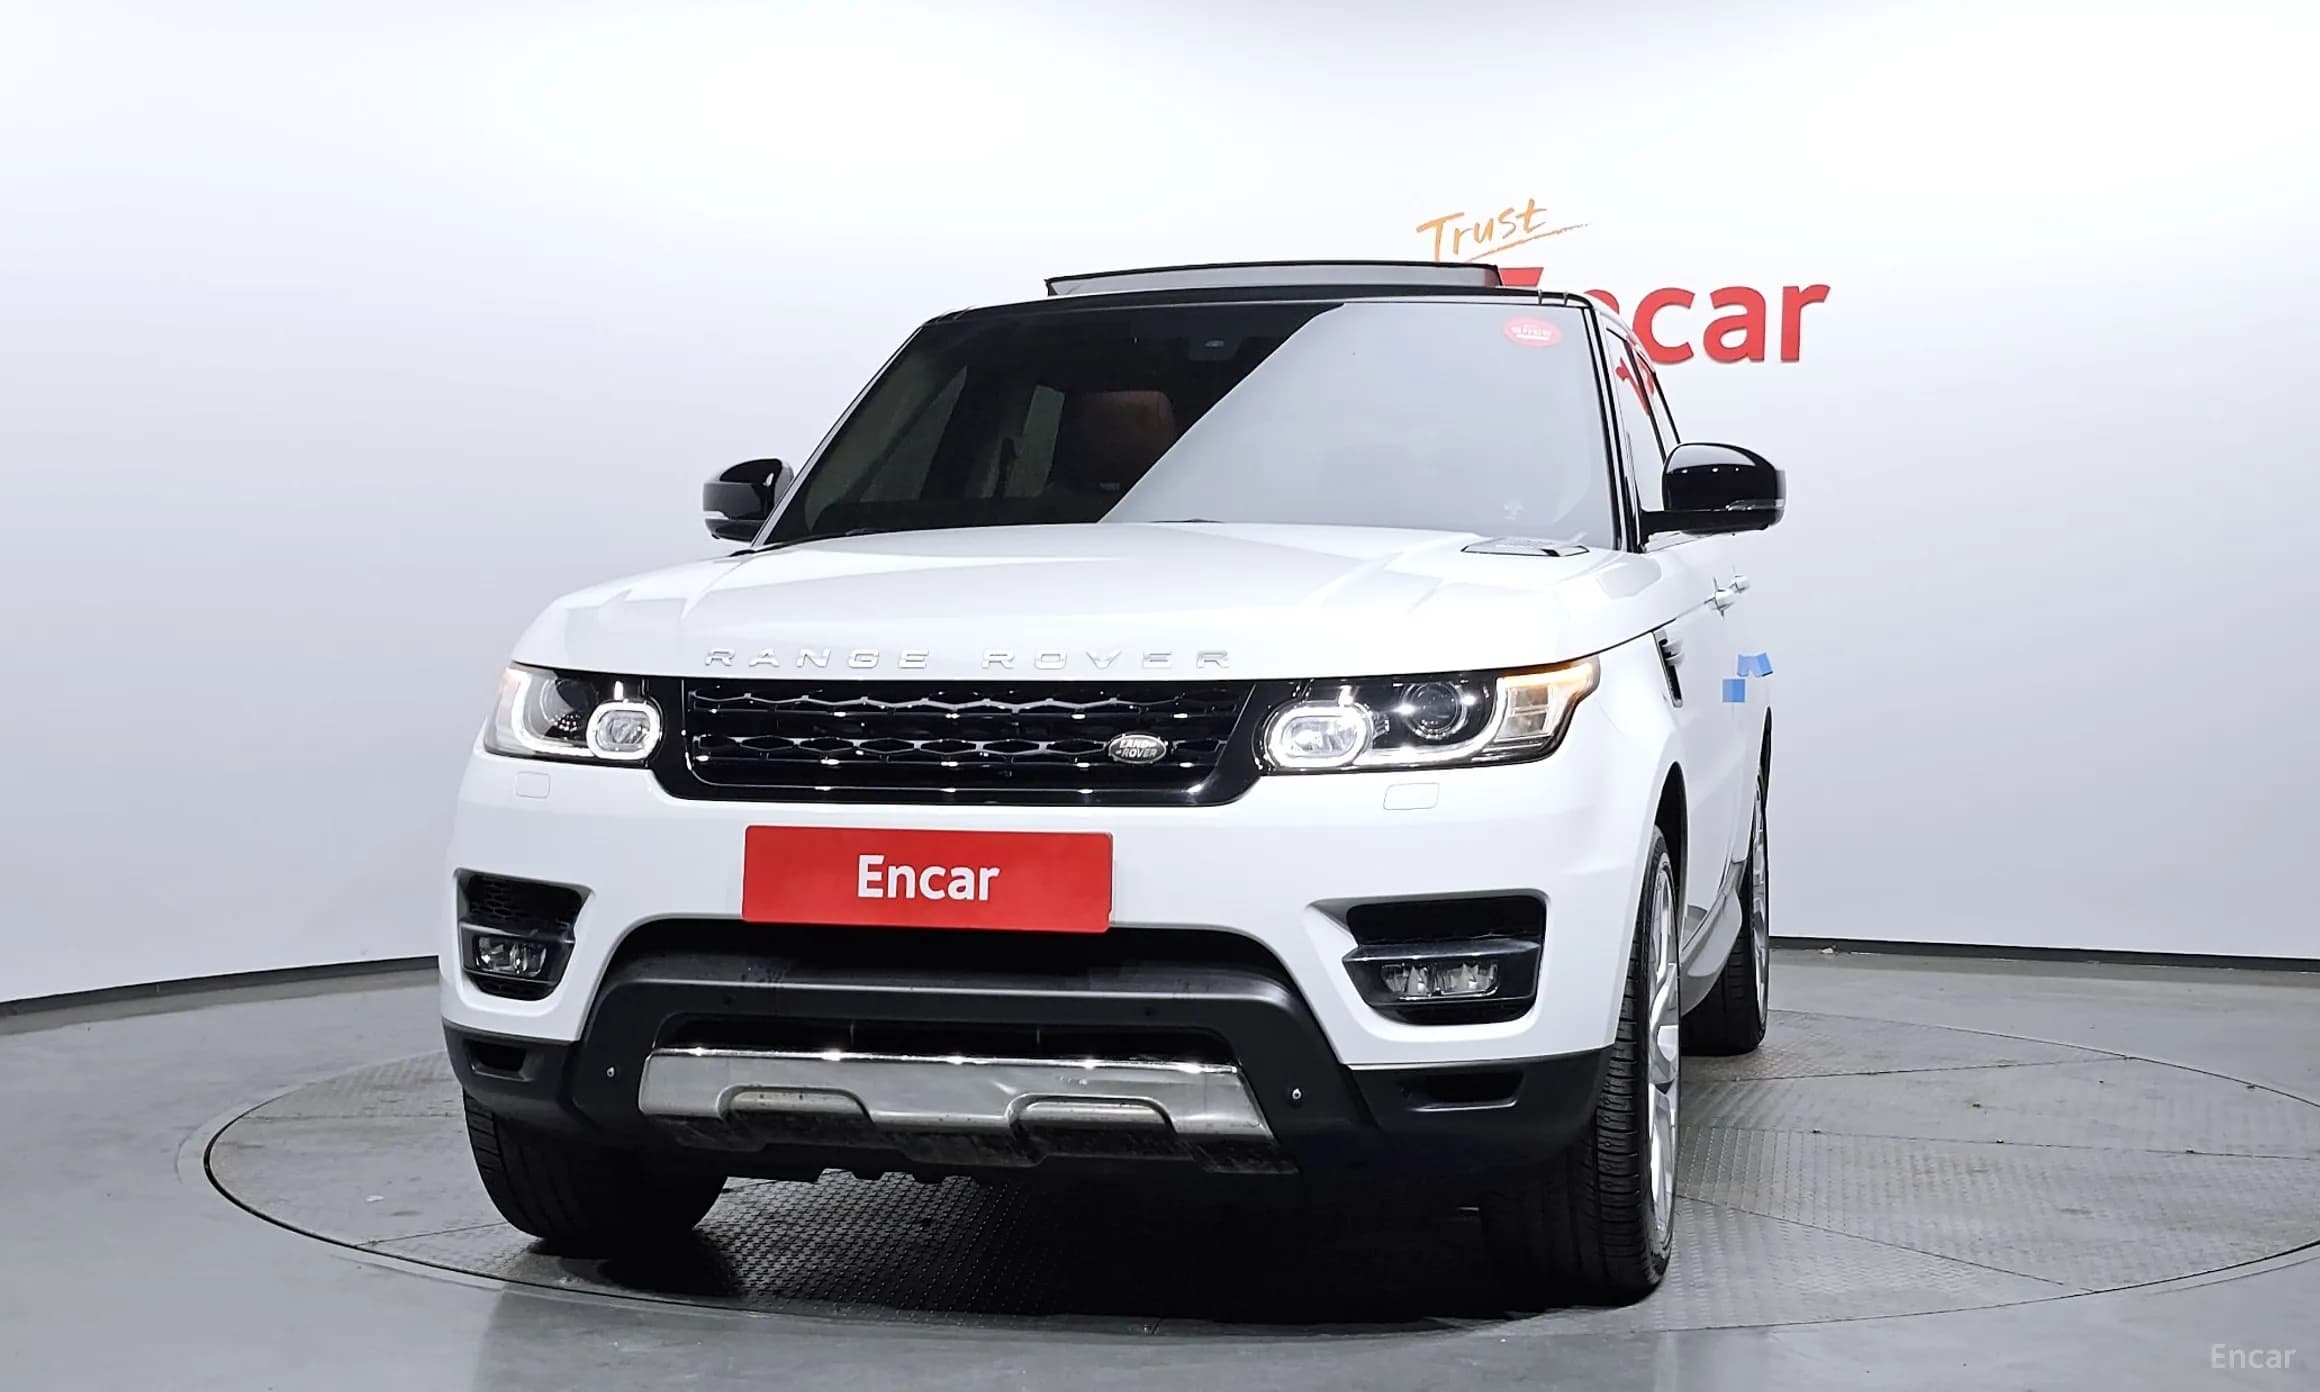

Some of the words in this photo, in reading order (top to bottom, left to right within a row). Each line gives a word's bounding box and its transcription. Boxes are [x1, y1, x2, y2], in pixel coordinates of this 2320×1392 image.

[1415, 198, 1548, 263] Trust
[1486, 267, 1831, 365] car
[704, 648, 929, 668] RANGE
[980, 648, 1231, 669] ROVER
[1120, 739, 1152, 748] LAND
[857, 853, 1000, 901] Encar
